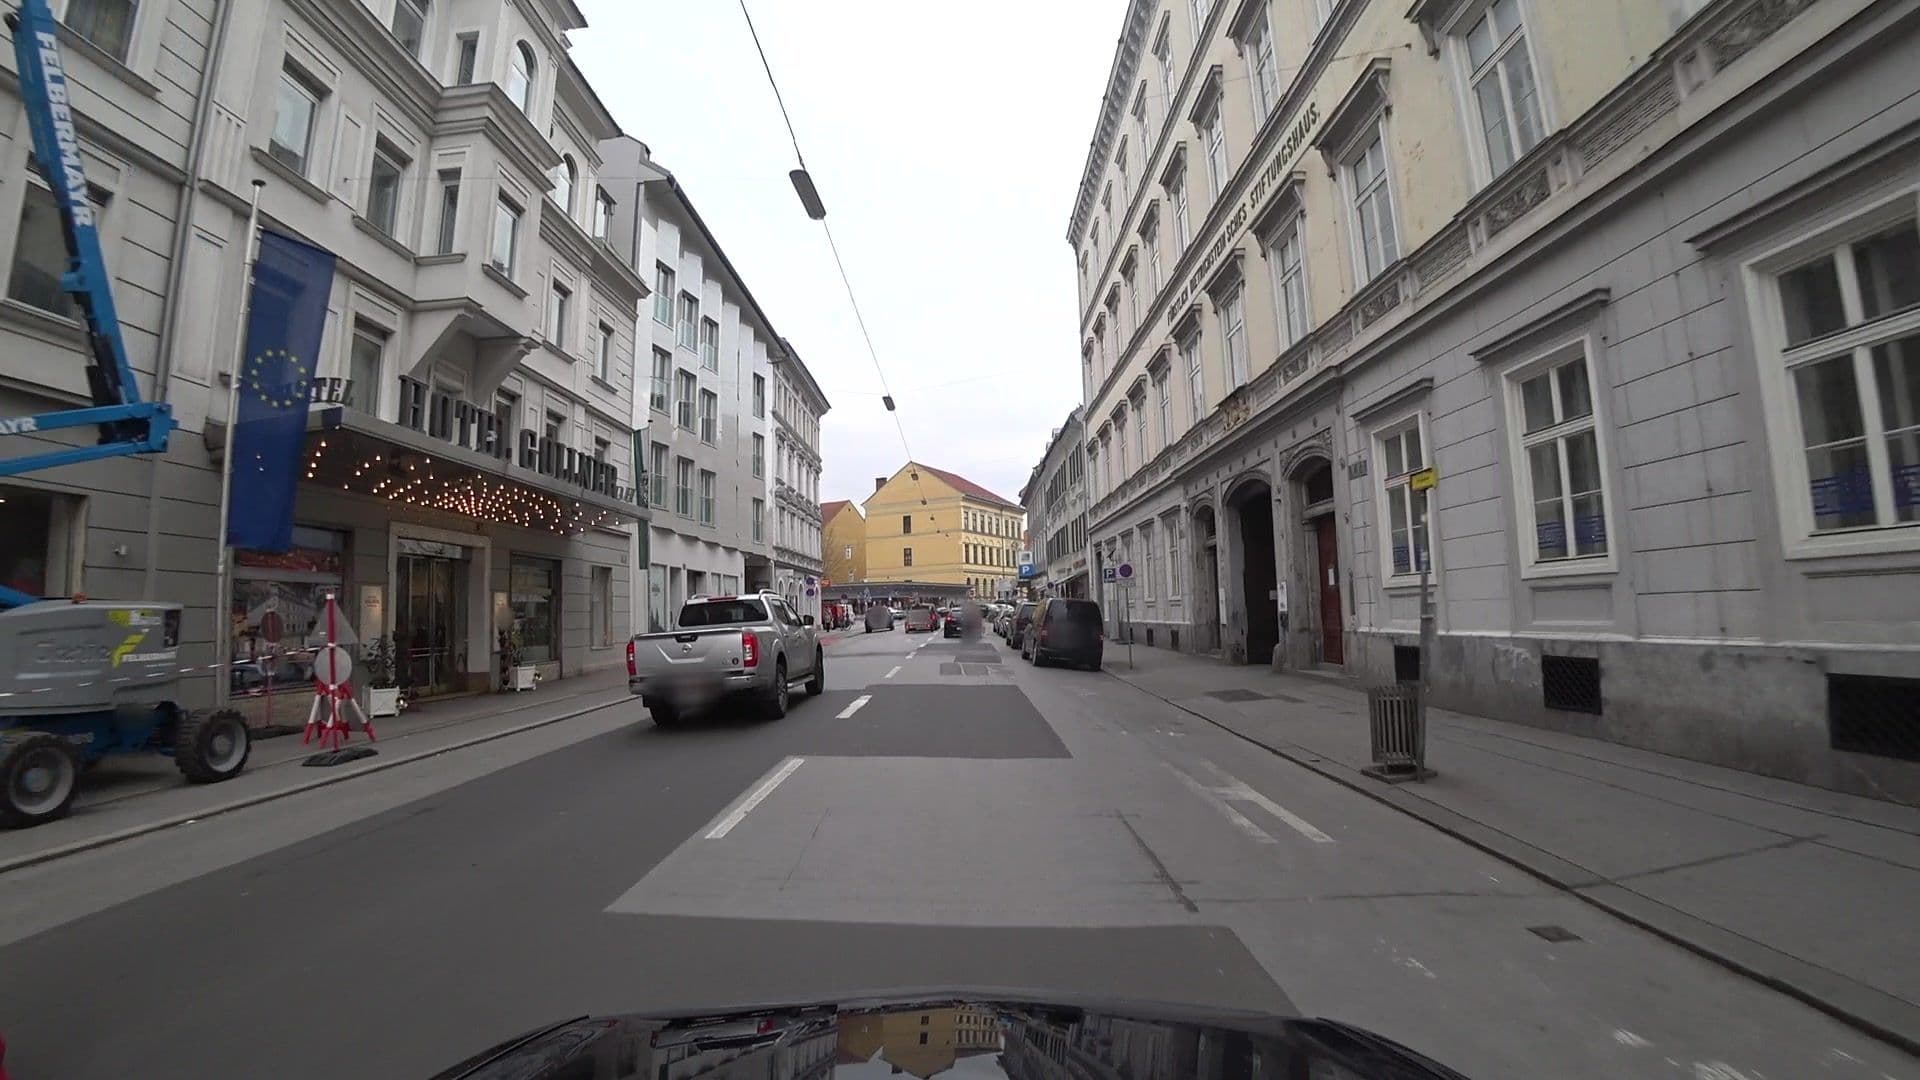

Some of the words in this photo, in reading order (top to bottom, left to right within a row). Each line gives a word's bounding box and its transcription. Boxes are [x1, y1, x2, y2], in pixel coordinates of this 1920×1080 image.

[35, 31, 97, 226] FELBERMAYR
[311, 378, 355, 405] TEL
[398, 374, 512, 459] HOTEL
